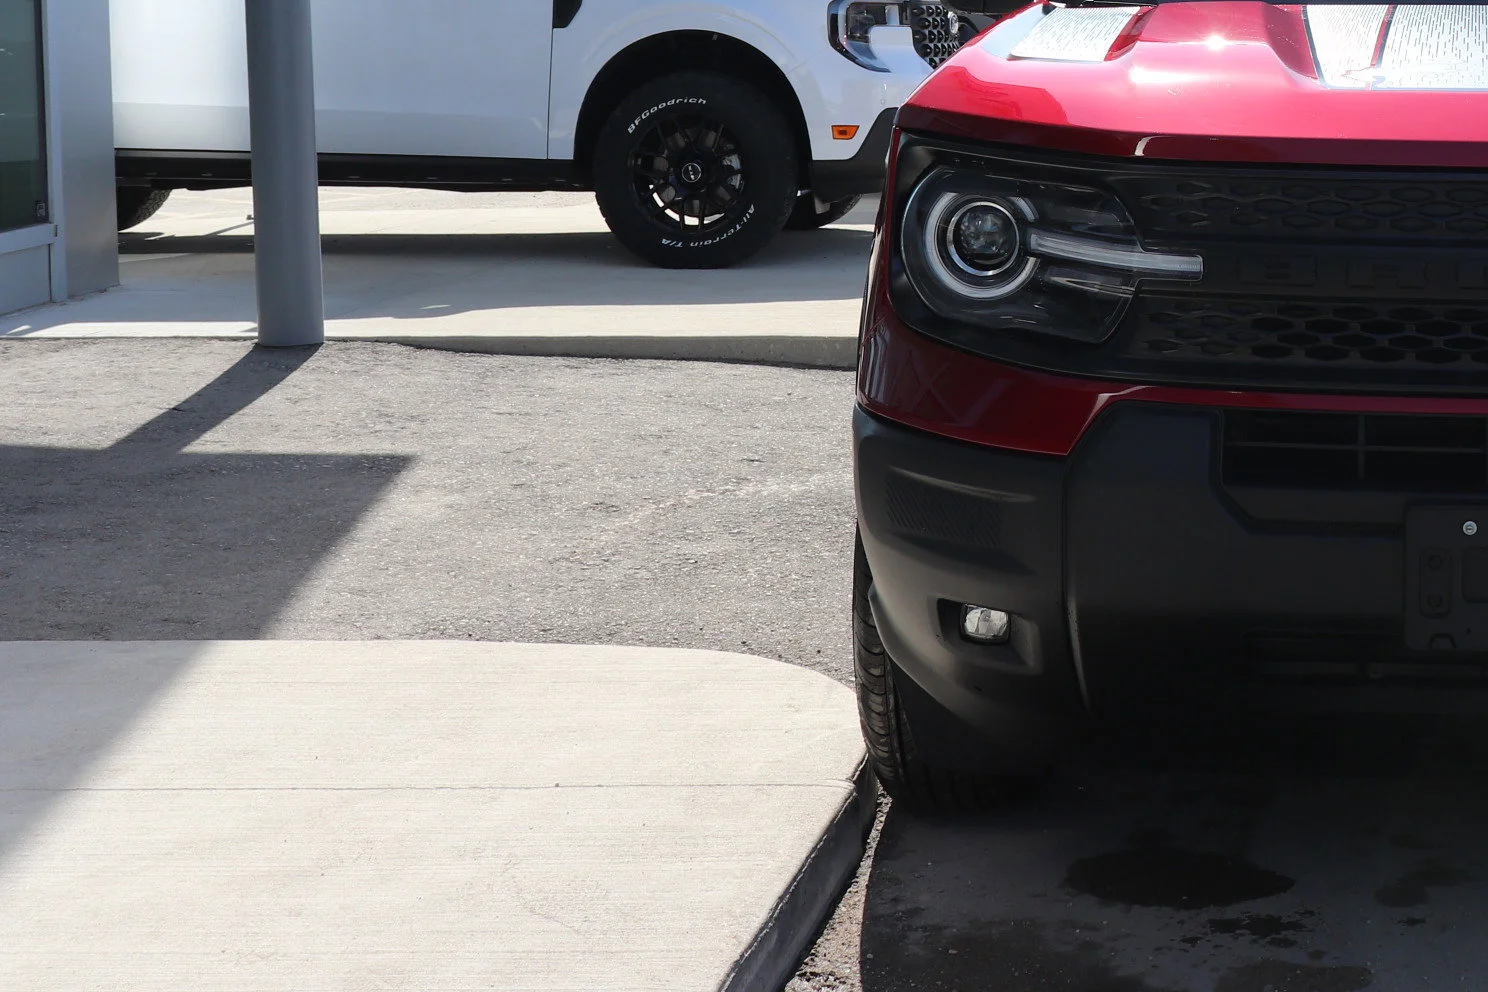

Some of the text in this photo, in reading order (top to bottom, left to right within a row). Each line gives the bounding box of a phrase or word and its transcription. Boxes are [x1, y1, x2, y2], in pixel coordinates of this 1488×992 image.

[627, 96, 707, 134] BFGoodrich
[661, 204, 755, 248] All-Terrain T/A
